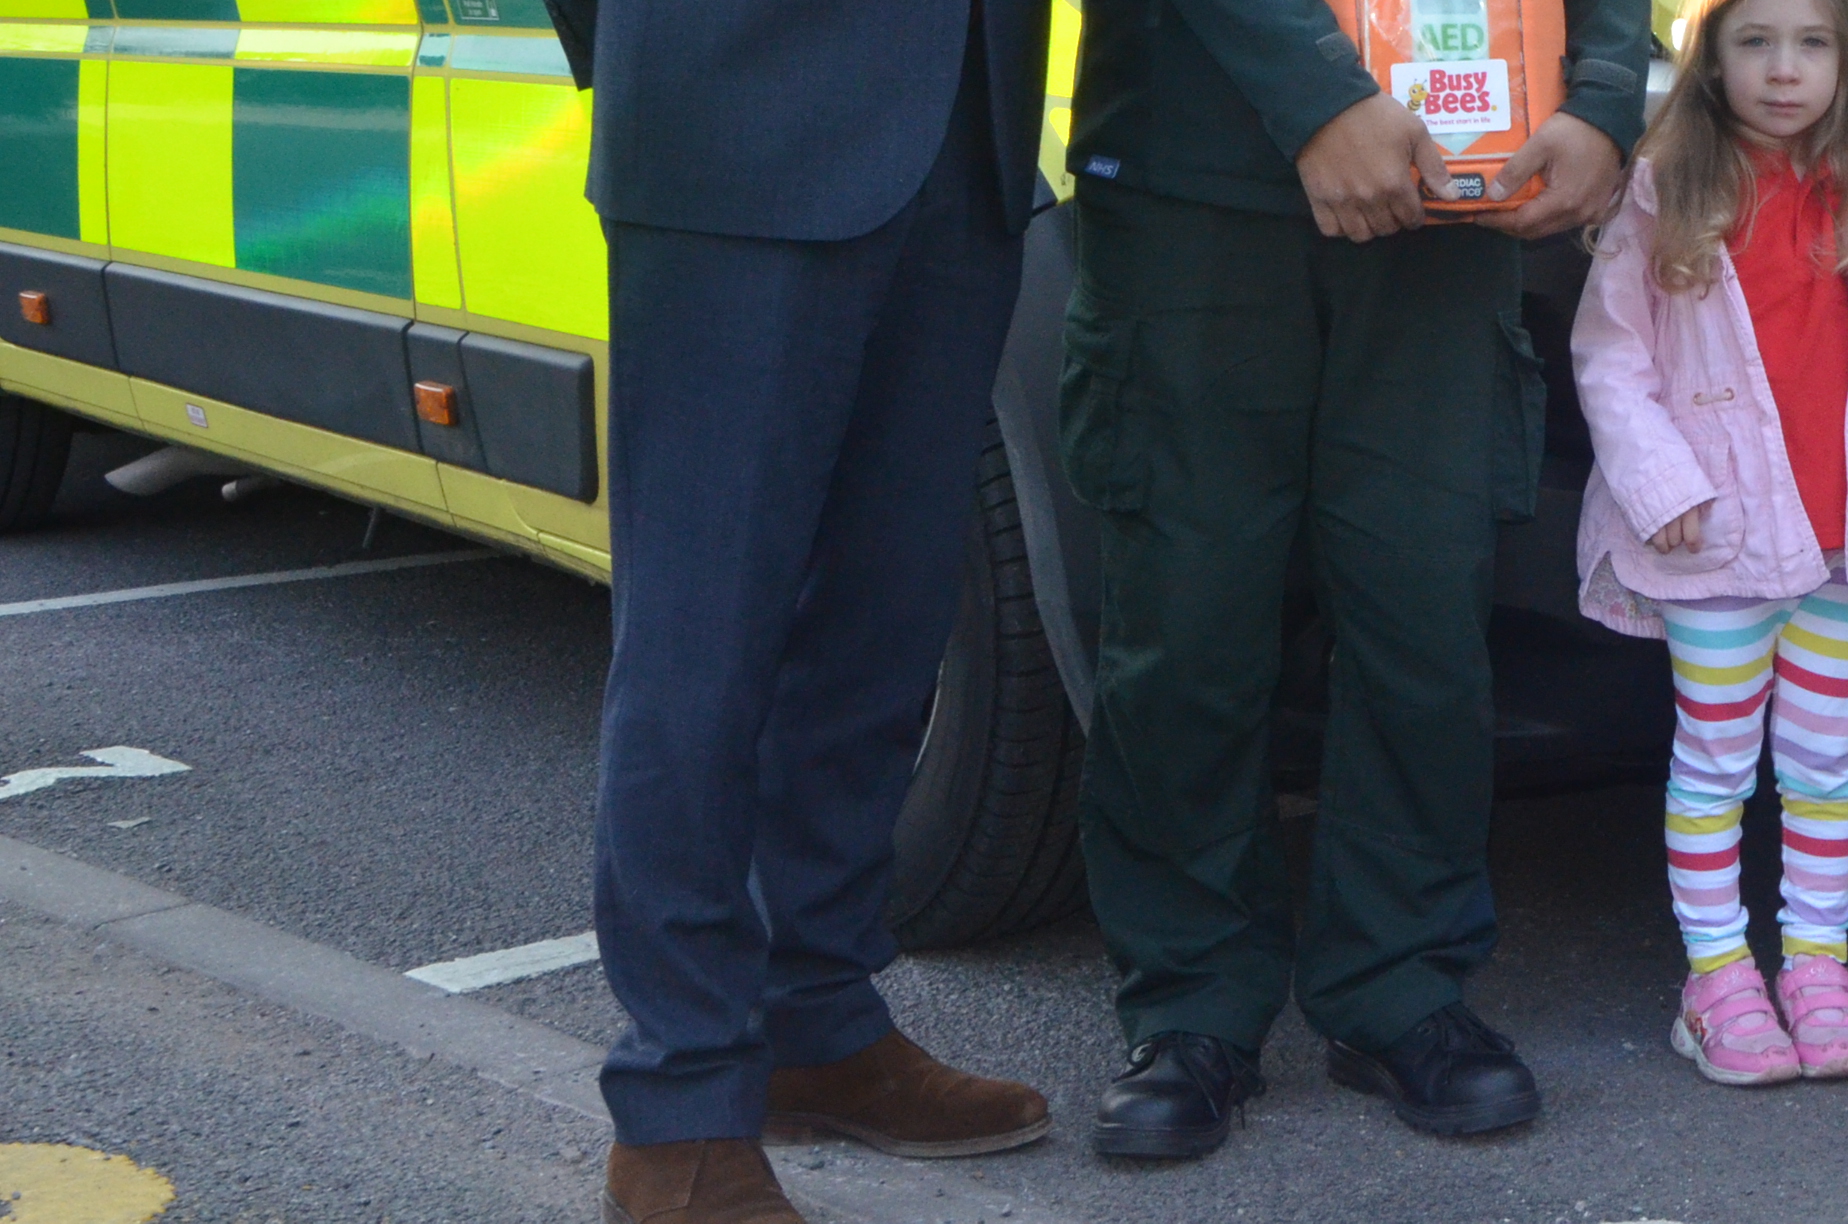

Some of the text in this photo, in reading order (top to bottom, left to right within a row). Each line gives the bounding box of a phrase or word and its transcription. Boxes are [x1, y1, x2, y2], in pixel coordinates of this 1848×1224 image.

[1417, 23, 1484, 51] AED
[1429, 69, 1487, 94] Busy
[1440, 118, 1454, 126] best
[1456, 117, 1472, 125] start
[1089, 161, 1114, 175] NHS
[1454, 178, 1481, 188] RDIAC
